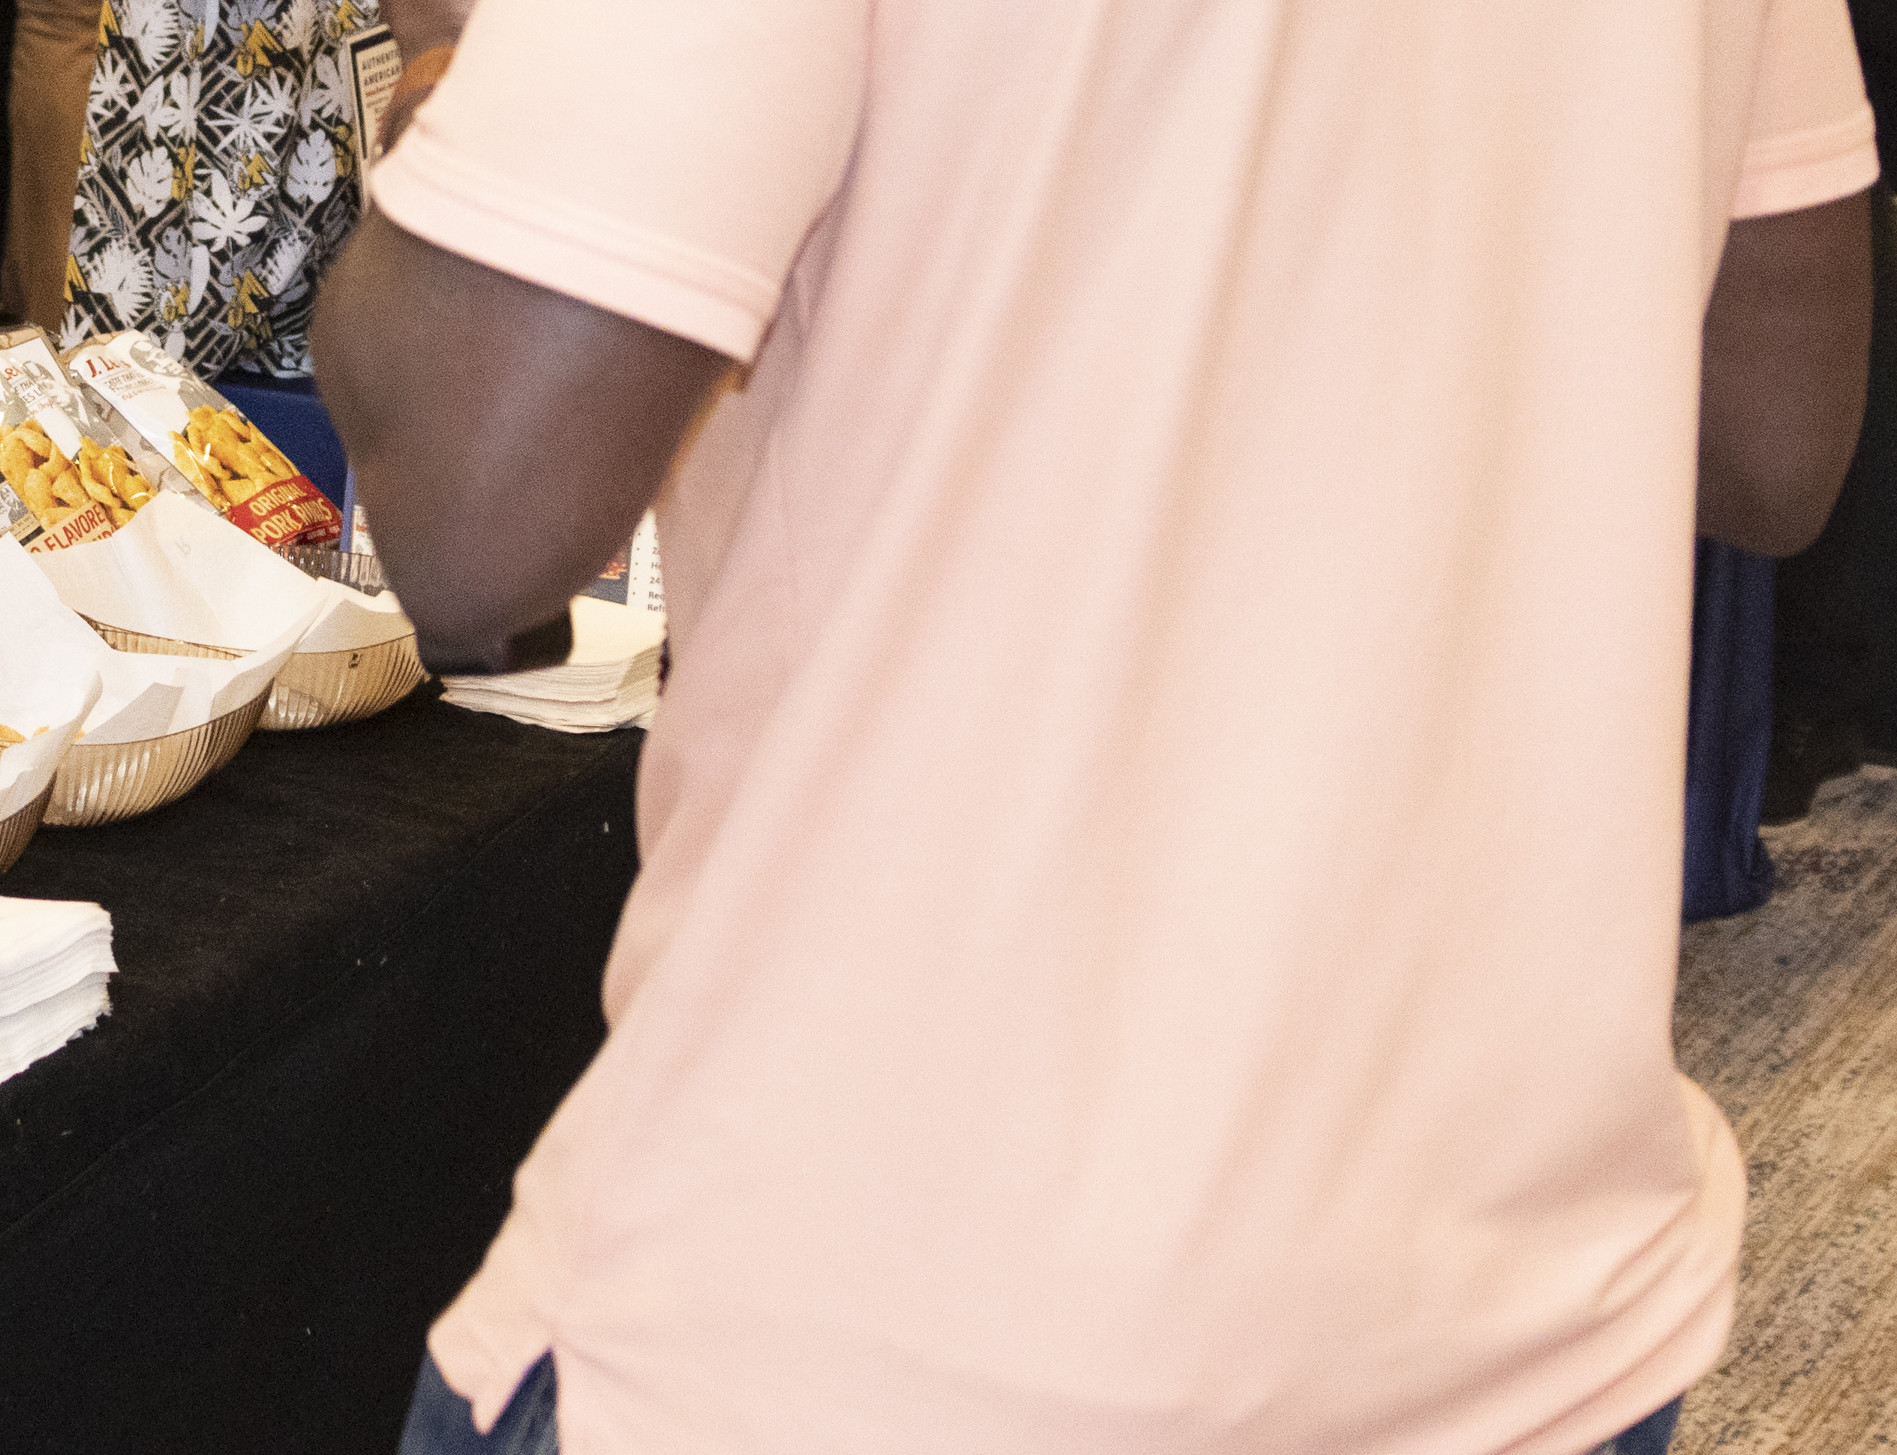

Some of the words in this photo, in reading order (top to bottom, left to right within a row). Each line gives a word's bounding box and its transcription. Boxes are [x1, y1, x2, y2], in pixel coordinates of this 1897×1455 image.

[362, 49, 398, 72] AUTHENT
[85, 358, 101, 378] J.
[247, 480, 307, 517] ORIGINAL
[43, 503, 107, 552] FLAVORE
[249, 509, 302, 544] PORK
[292, 497, 333, 526] RINDS
